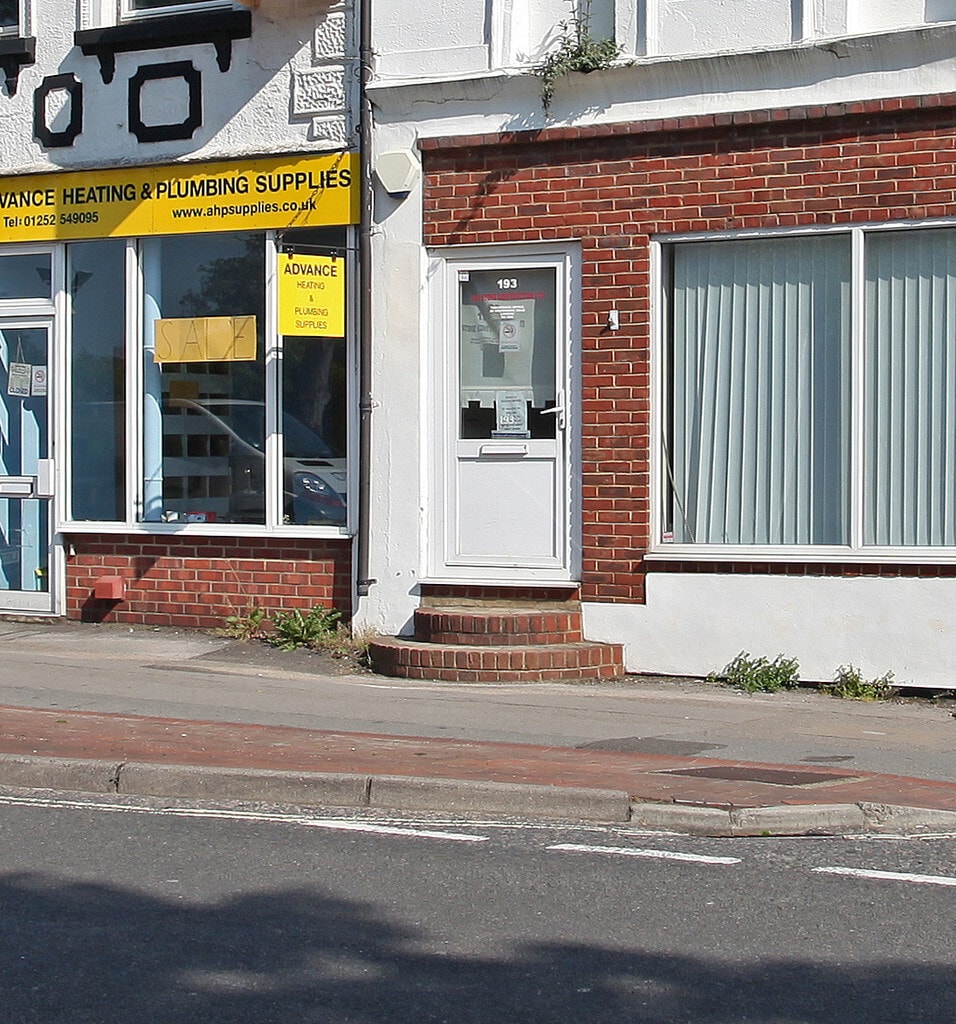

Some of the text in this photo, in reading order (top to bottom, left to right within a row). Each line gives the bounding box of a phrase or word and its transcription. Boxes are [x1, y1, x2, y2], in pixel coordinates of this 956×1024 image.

[63, 184, 136, 205] HEATING
[140, 182, 152, 201] &
[156, 176, 249, 200] PLUMBING
[255, 169, 351, 193] SUPPLIES
[172, 198, 317, 219] www.ahpsupplies.co.uk
[24, 214, 56, 227] 01252
[60, 212, 99, 224] 549095
[284, 263, 338, 277] ADVANCE
[296, 280, 325, 290] HEATING
[497, 278, 518, 289] 193
[294, 307, 329, 317] PLUMBING
[295, 320, 327, 330] SUPPLIES
[158, 318, 255, 360] SALE
